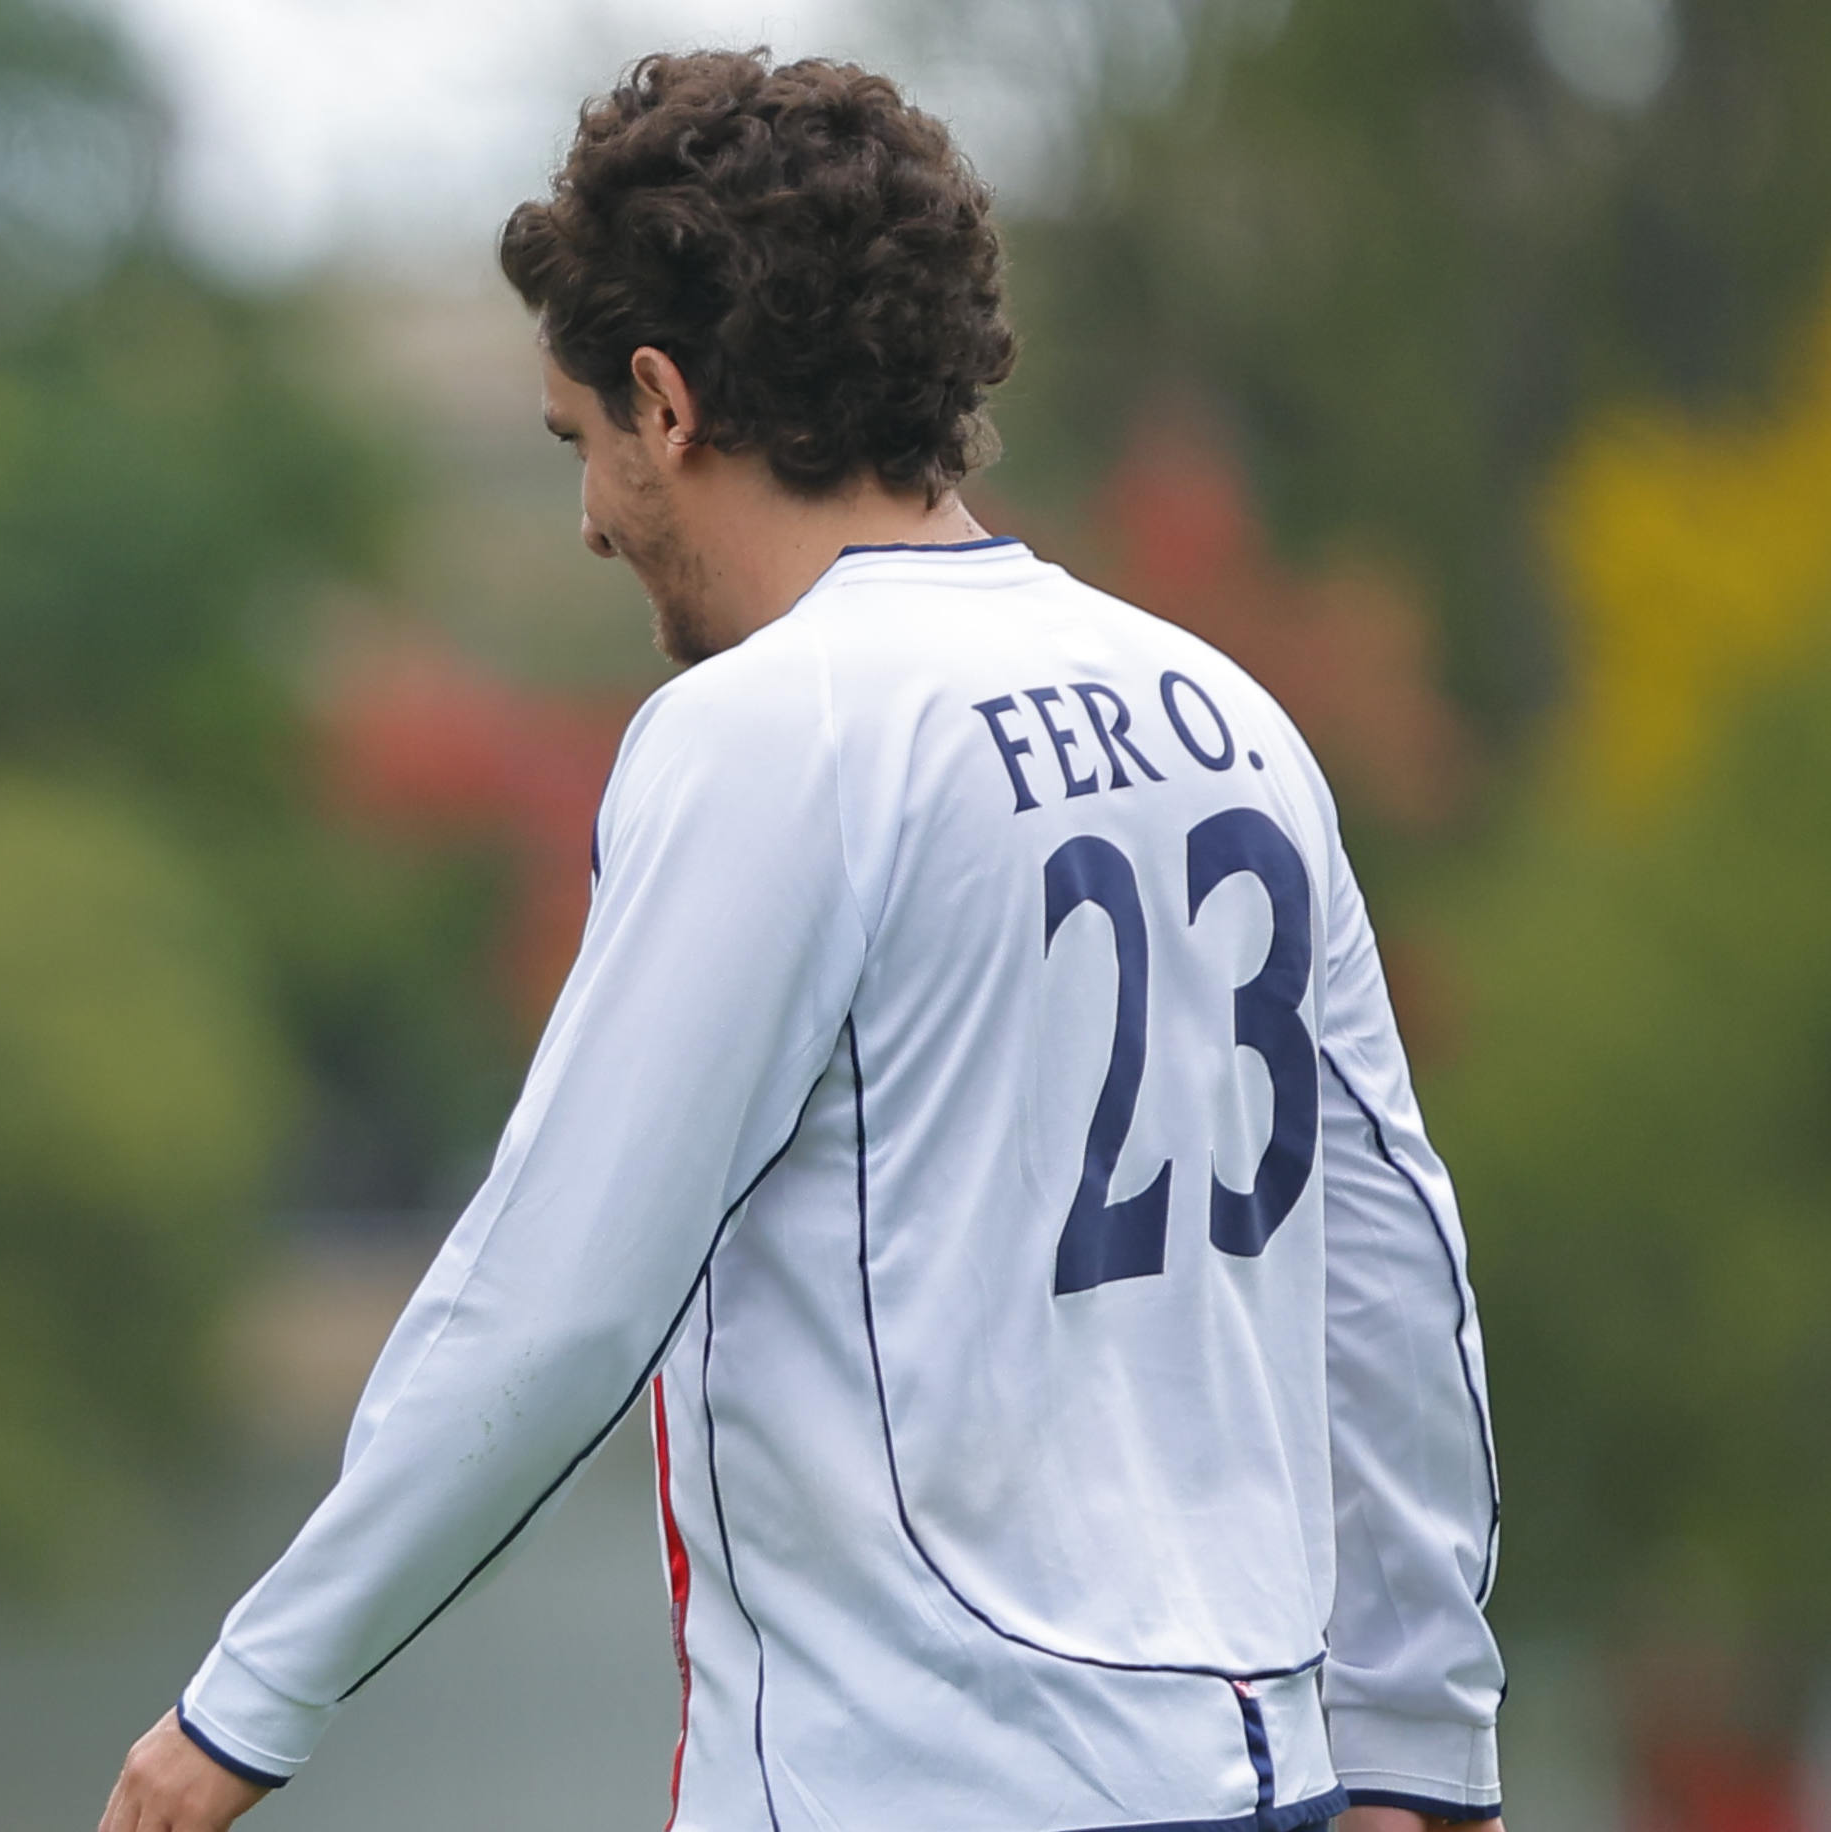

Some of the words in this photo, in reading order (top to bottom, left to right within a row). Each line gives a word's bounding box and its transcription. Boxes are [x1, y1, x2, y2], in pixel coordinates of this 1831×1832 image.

[971, 682, 1167, 814] FER
[1158, 670, 1265, 772] O.
[1043, 806, 1320, 1296] 23
